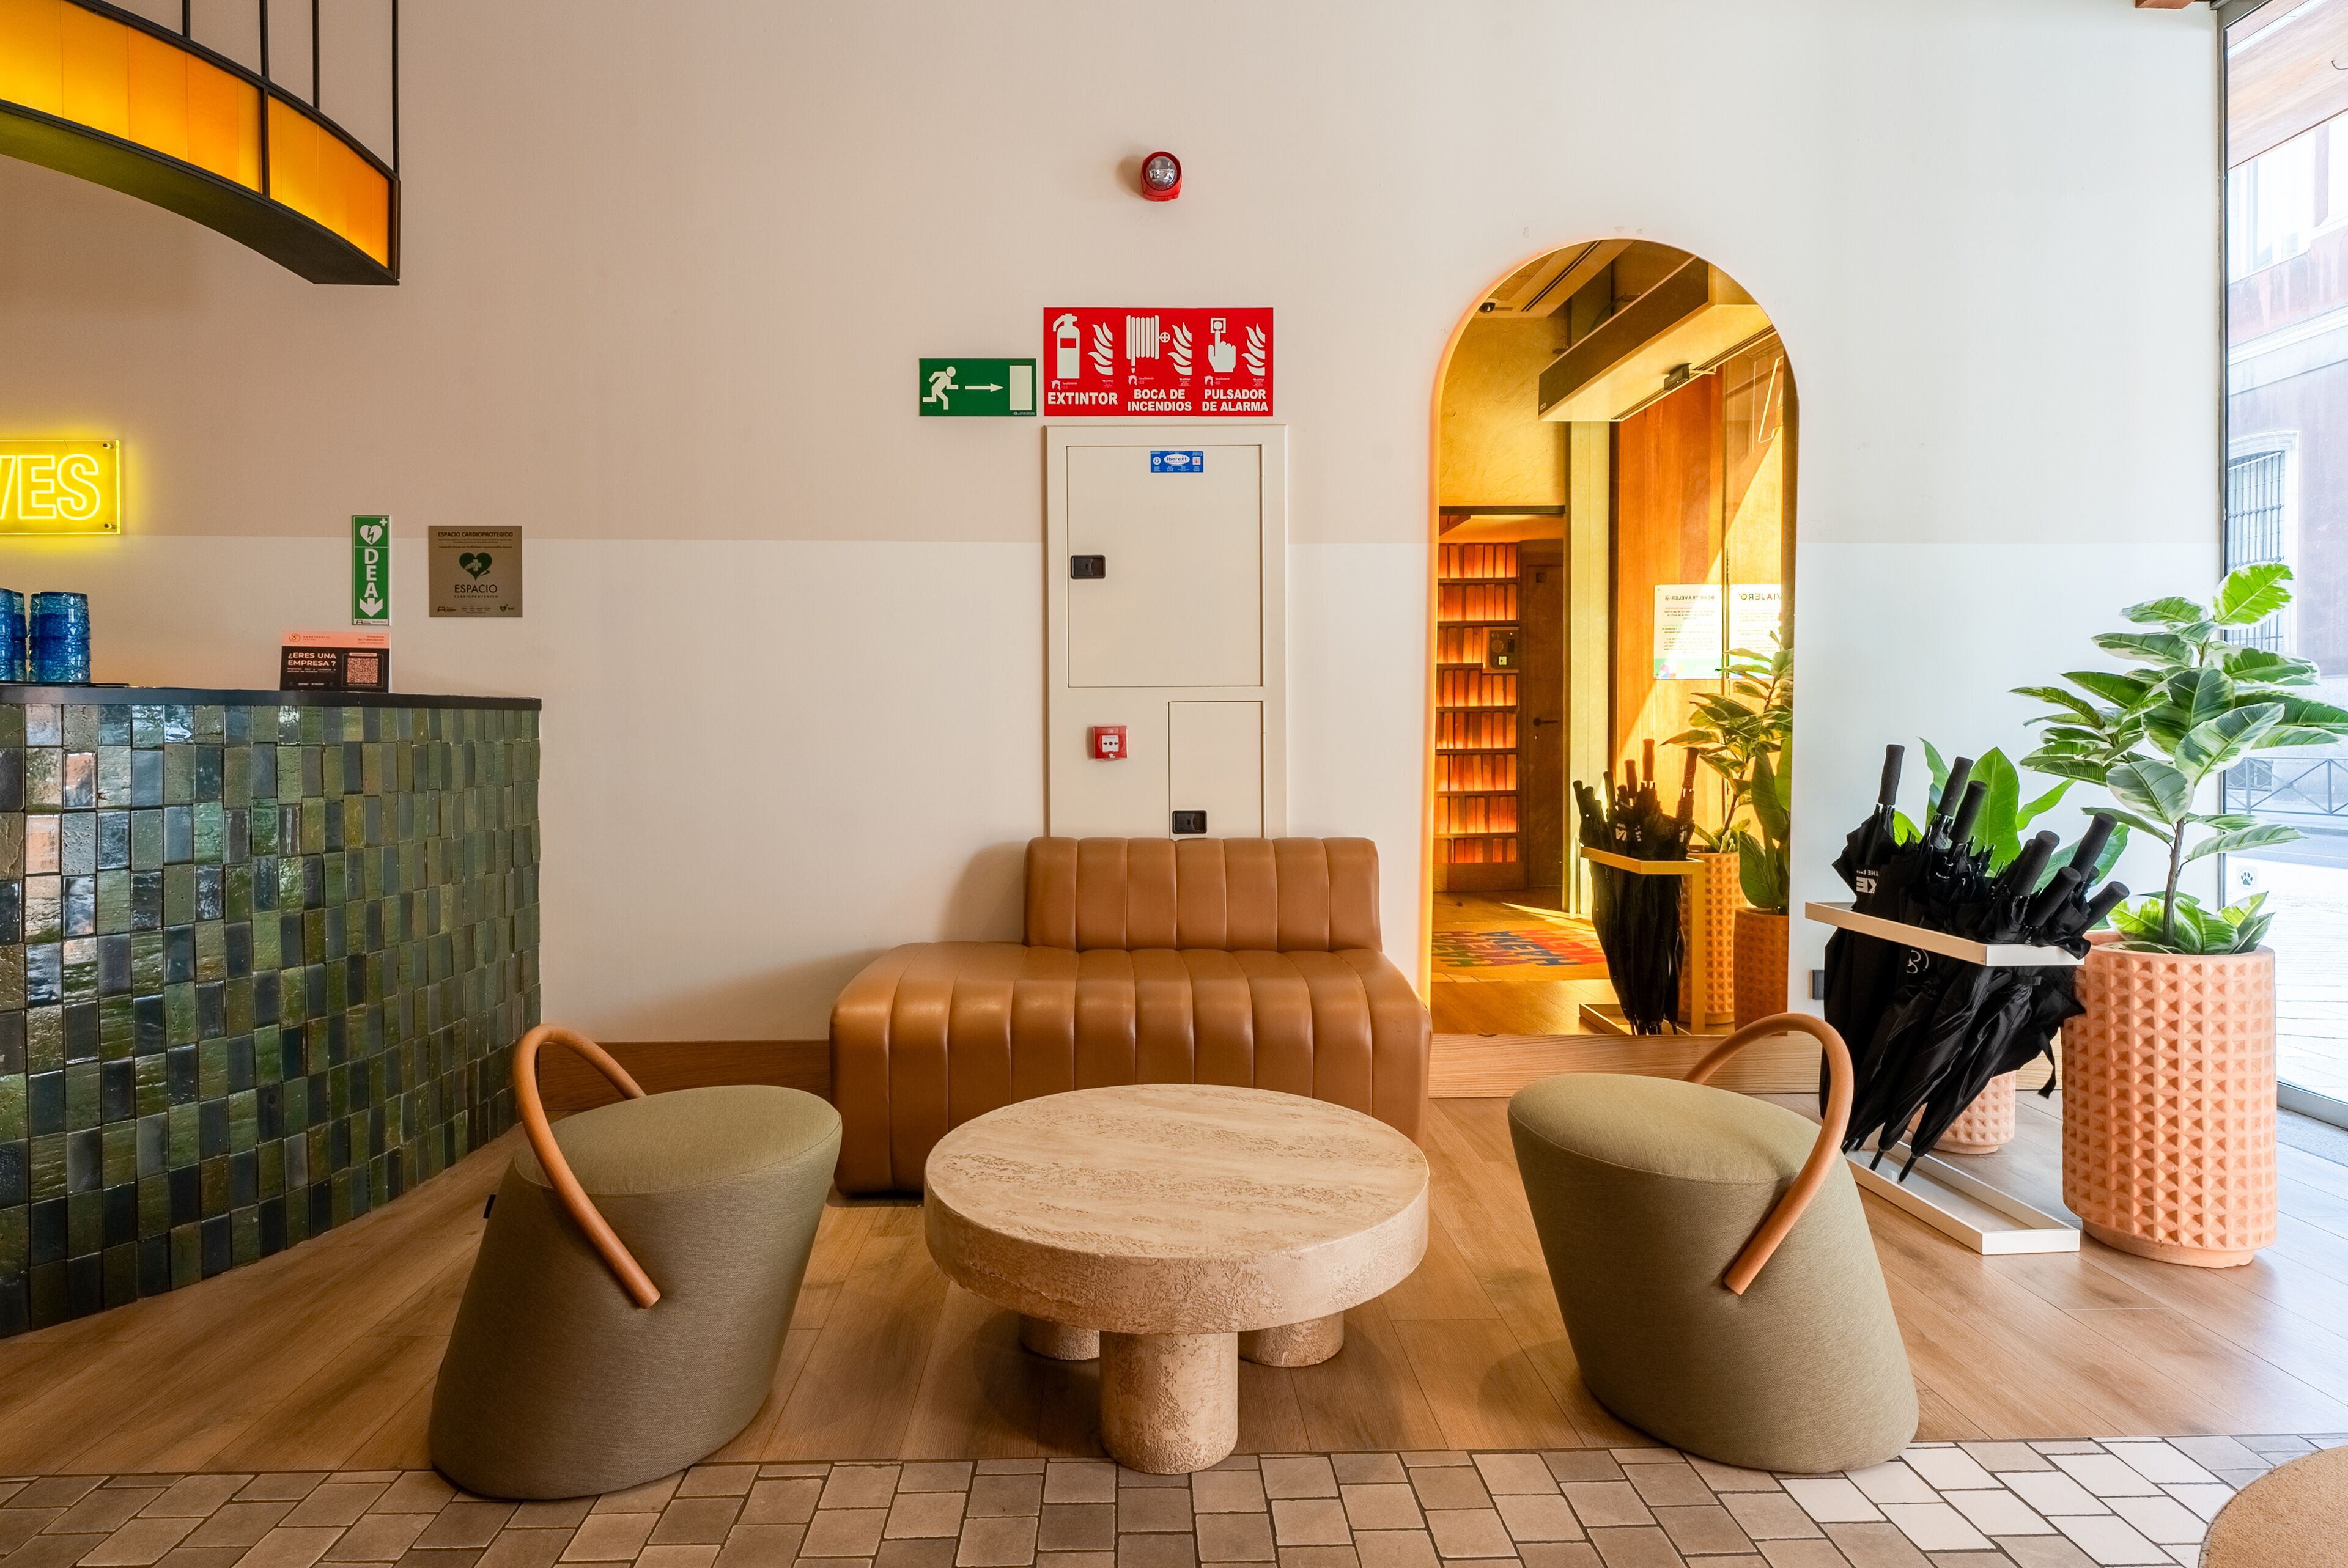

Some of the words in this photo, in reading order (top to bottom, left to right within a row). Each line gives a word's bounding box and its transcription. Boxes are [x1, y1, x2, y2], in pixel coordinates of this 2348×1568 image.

[1047, 392, 1118, 405] EXTINTOR
[1134, 389, 1167, 399] BOCA
[1169, 389, 1185, 399] DE
[1204, 389, 1266, 400] PULSADOR
[1127, 401, 1192, 411] INCENDIOS
[1202, 401, 1218, 411] DE
[1220, 401, 1268, 411] ALARMA
[364, 548, 379, 598] DEA
[454, 584, 498, 594] ESPACIO
